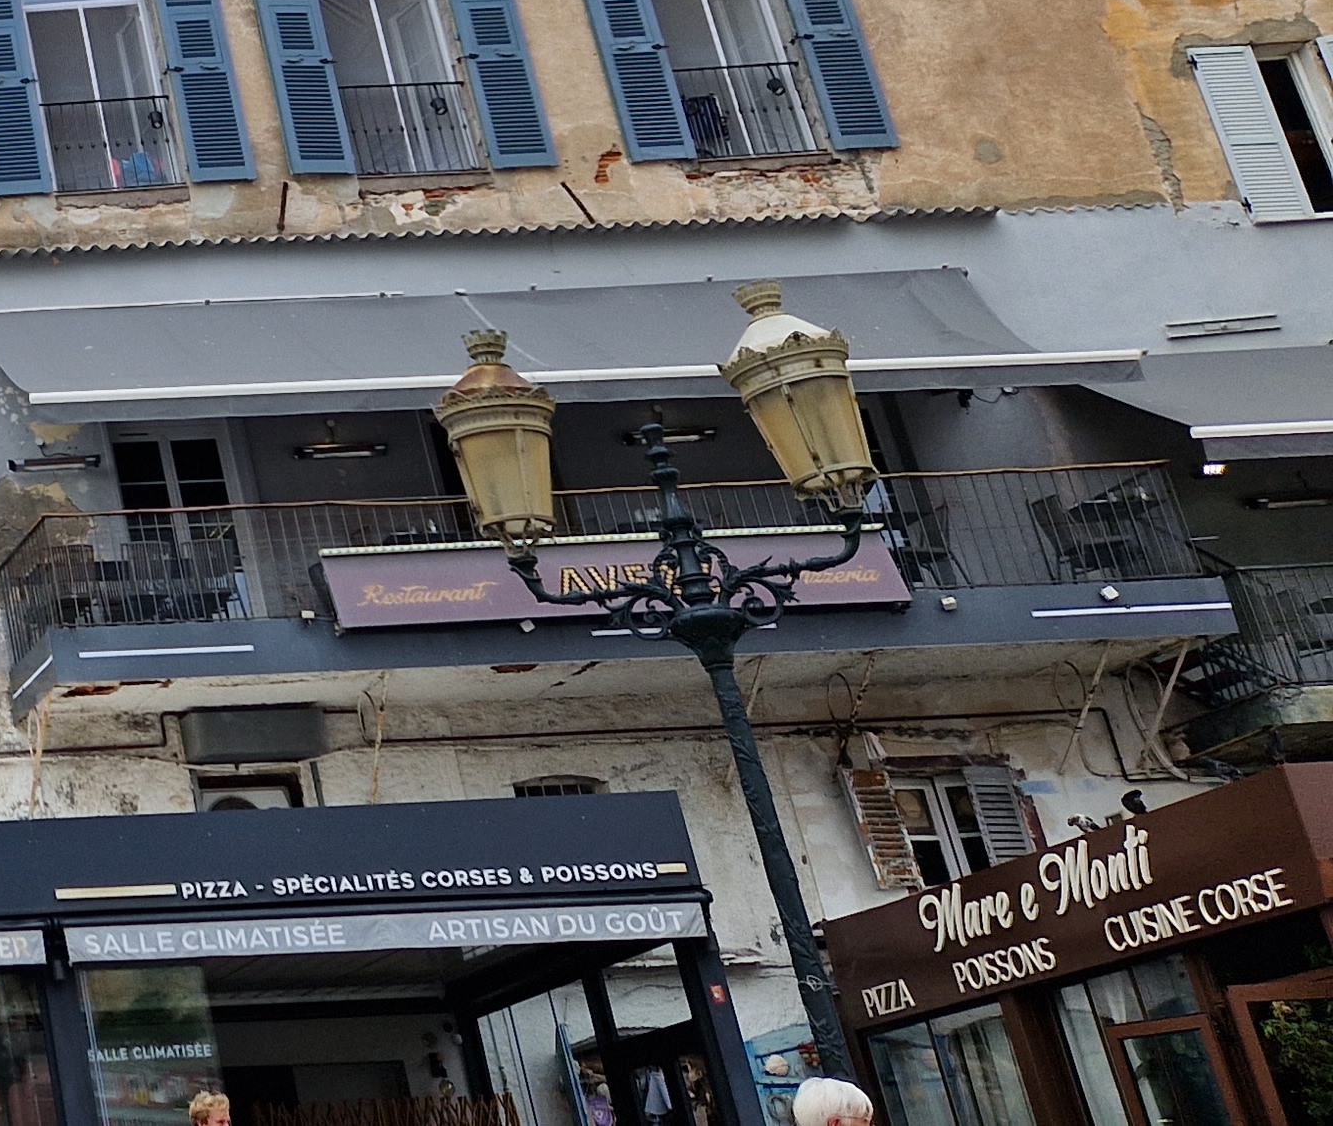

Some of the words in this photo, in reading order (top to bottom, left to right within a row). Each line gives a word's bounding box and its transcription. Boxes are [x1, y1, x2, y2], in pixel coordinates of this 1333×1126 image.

[356, 581, 500, 606] Restaurant
[181, 880, 248, 900] PIZZA
[272, 869, 415, 896] SPÉCIALITÉS
[421, 867, 512, 889] CORSES
[519, 866, 534, 885] &
[541, 862, 658, 883] POISSONS
[918, 882, 1014, 953] Mare
[1020, 882, 1040, 921] e
[1038, 824, 1154, 915] Monti
[428, 915, 551, 943] ARTISAN
[556, 912, 596, 936] DU
[605, 908, 684, 934] GOÛT
[1103, 895, 1201, 952] CUISINE
[1198, 868, 1295, 925] CORSE
[84, 931, 175, 955] SALLE
[182, 919, 346, 951] CLIMATISÉE
[952, 937, 1057, 994] POISSONS
[861, 979, 916, 1018] PIZZA
[87, 1046, 128, 1062] SALLE
[132, 1042, 213, 1060] CLIMATISÉE
